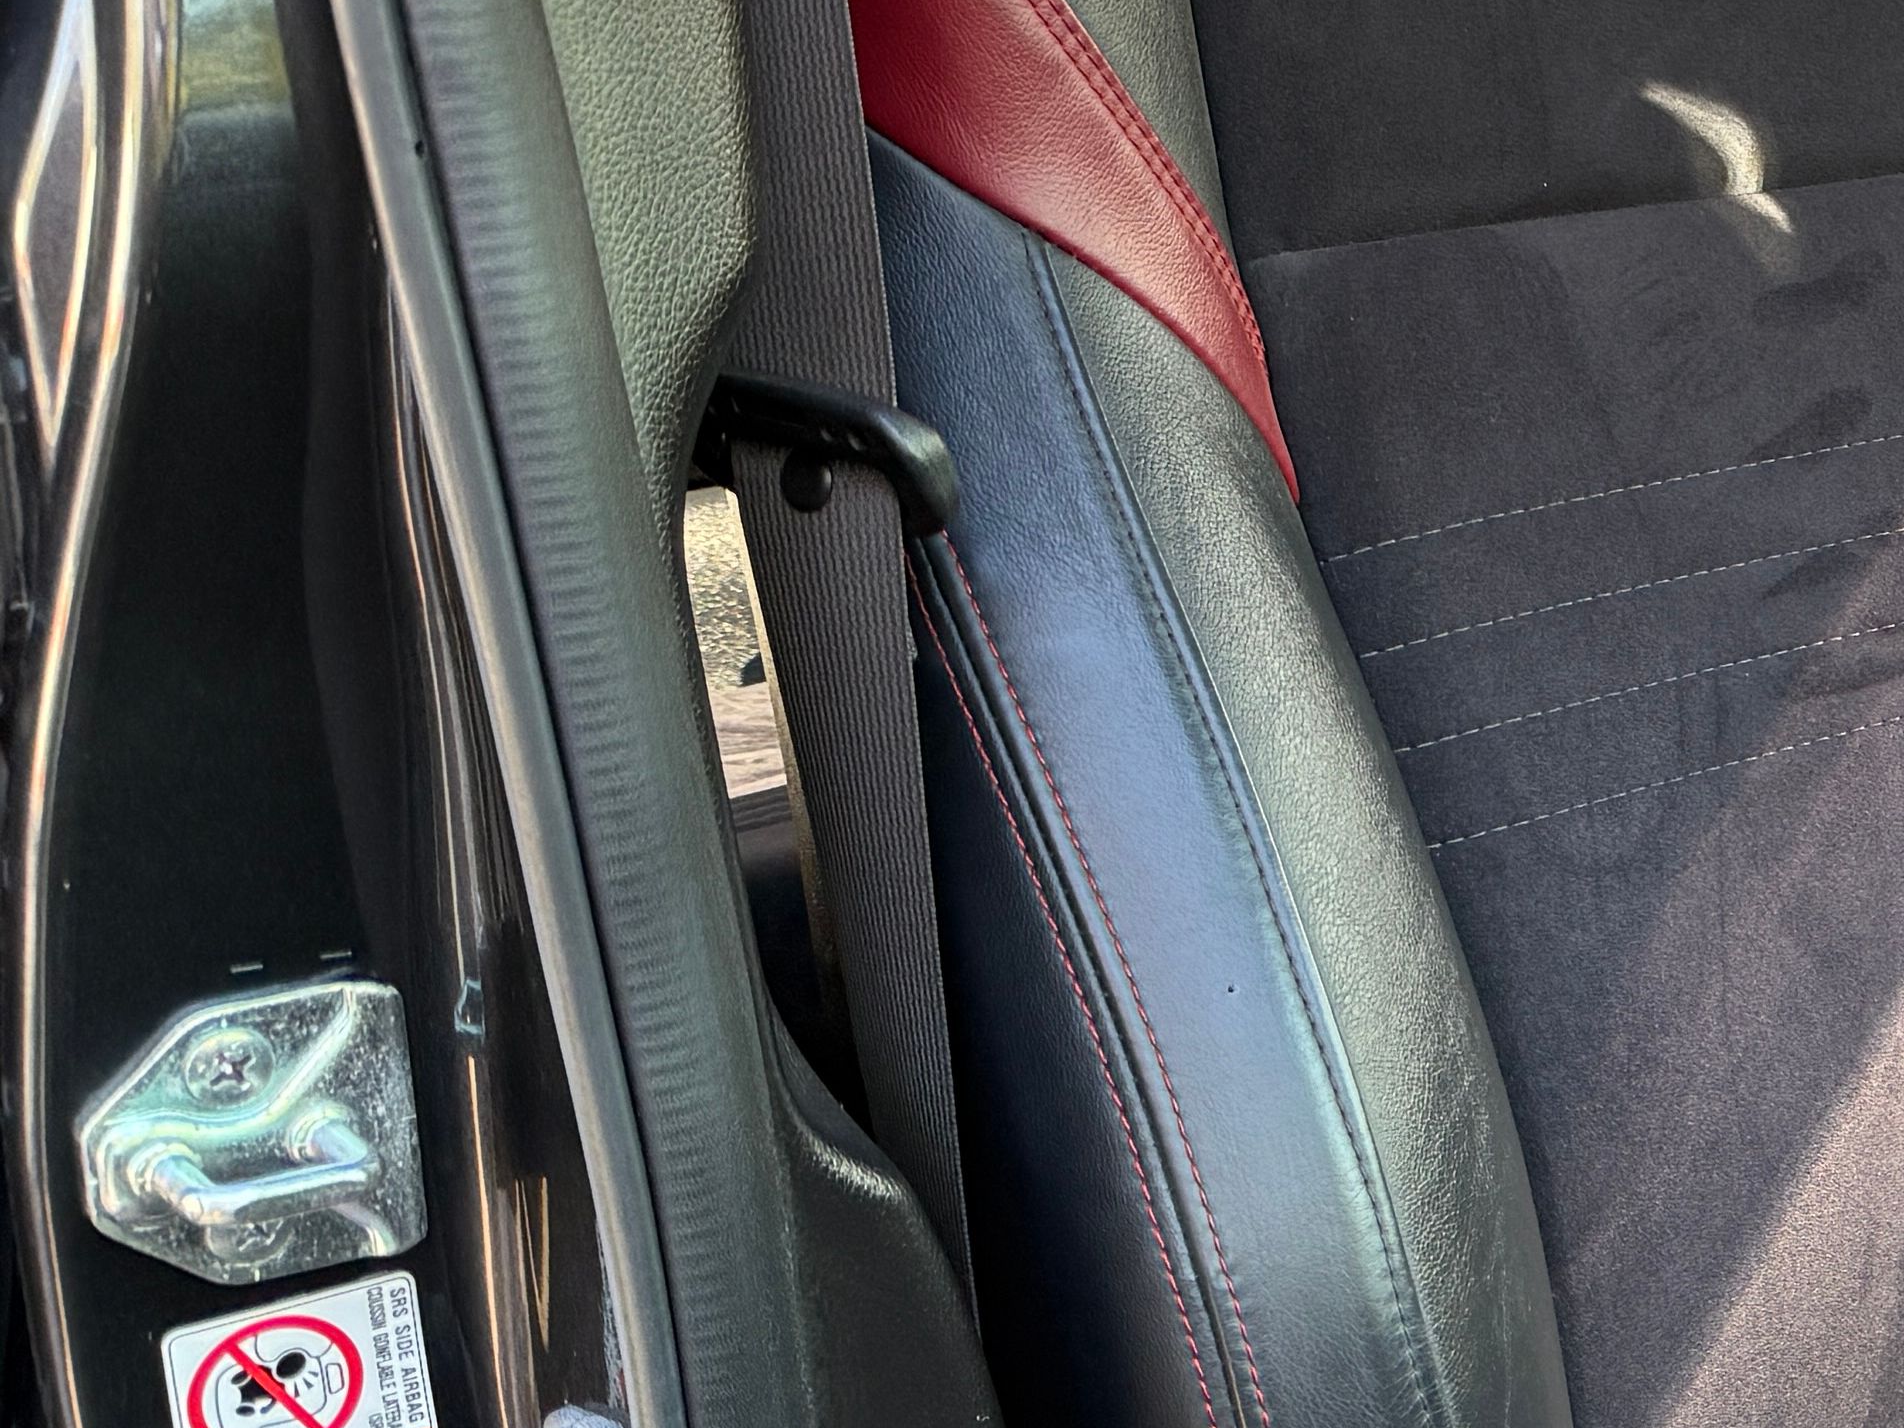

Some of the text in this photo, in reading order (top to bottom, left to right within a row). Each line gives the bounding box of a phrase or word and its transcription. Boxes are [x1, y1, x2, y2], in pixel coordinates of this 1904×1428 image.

[365, 1285, 388, 1330] COUSSIN
[371, 1332, 397, 1391] GONFLABLE
[388, 1286, 425, 1423] SRS SIDE AIRBAG
